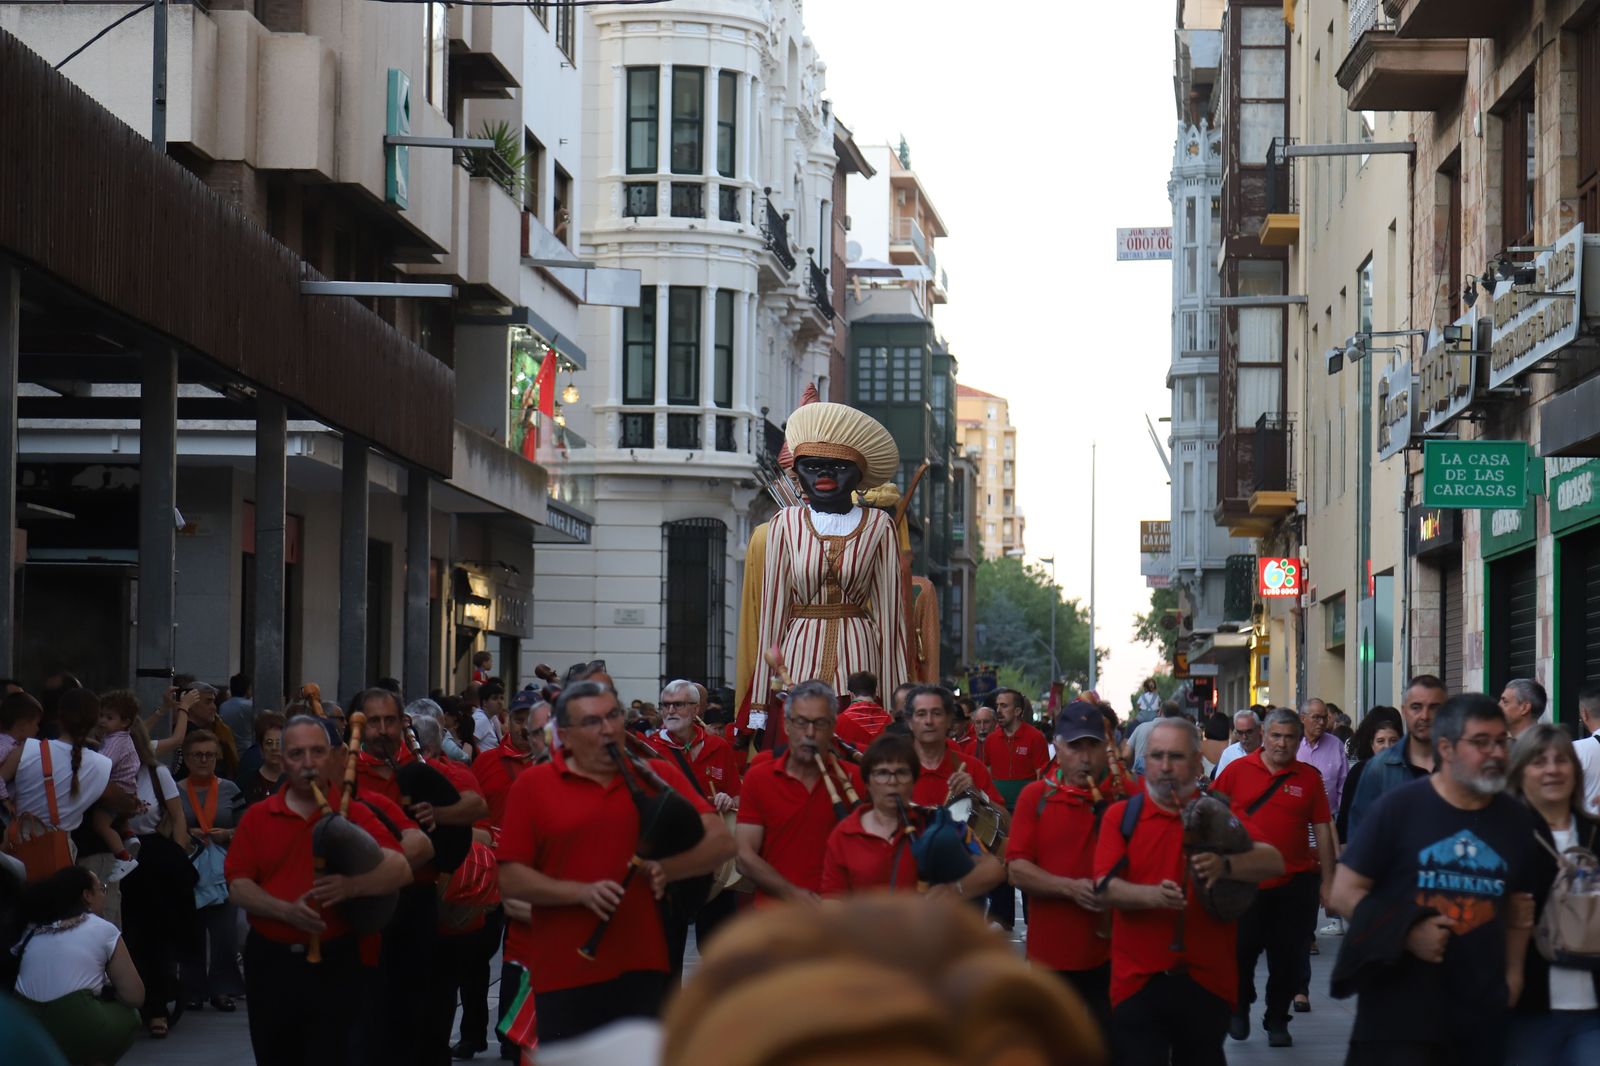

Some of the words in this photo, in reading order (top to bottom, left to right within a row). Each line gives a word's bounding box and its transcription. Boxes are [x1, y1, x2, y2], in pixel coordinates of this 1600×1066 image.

[1440, 453, 1463, 465] LA
[1468, 454, 1510, 466] CASA
[1445, 469, 1467, 481] DE
[1474, 469, 1505, 482] LAS
[1433, 484, 1517, 497] CARCASAS
